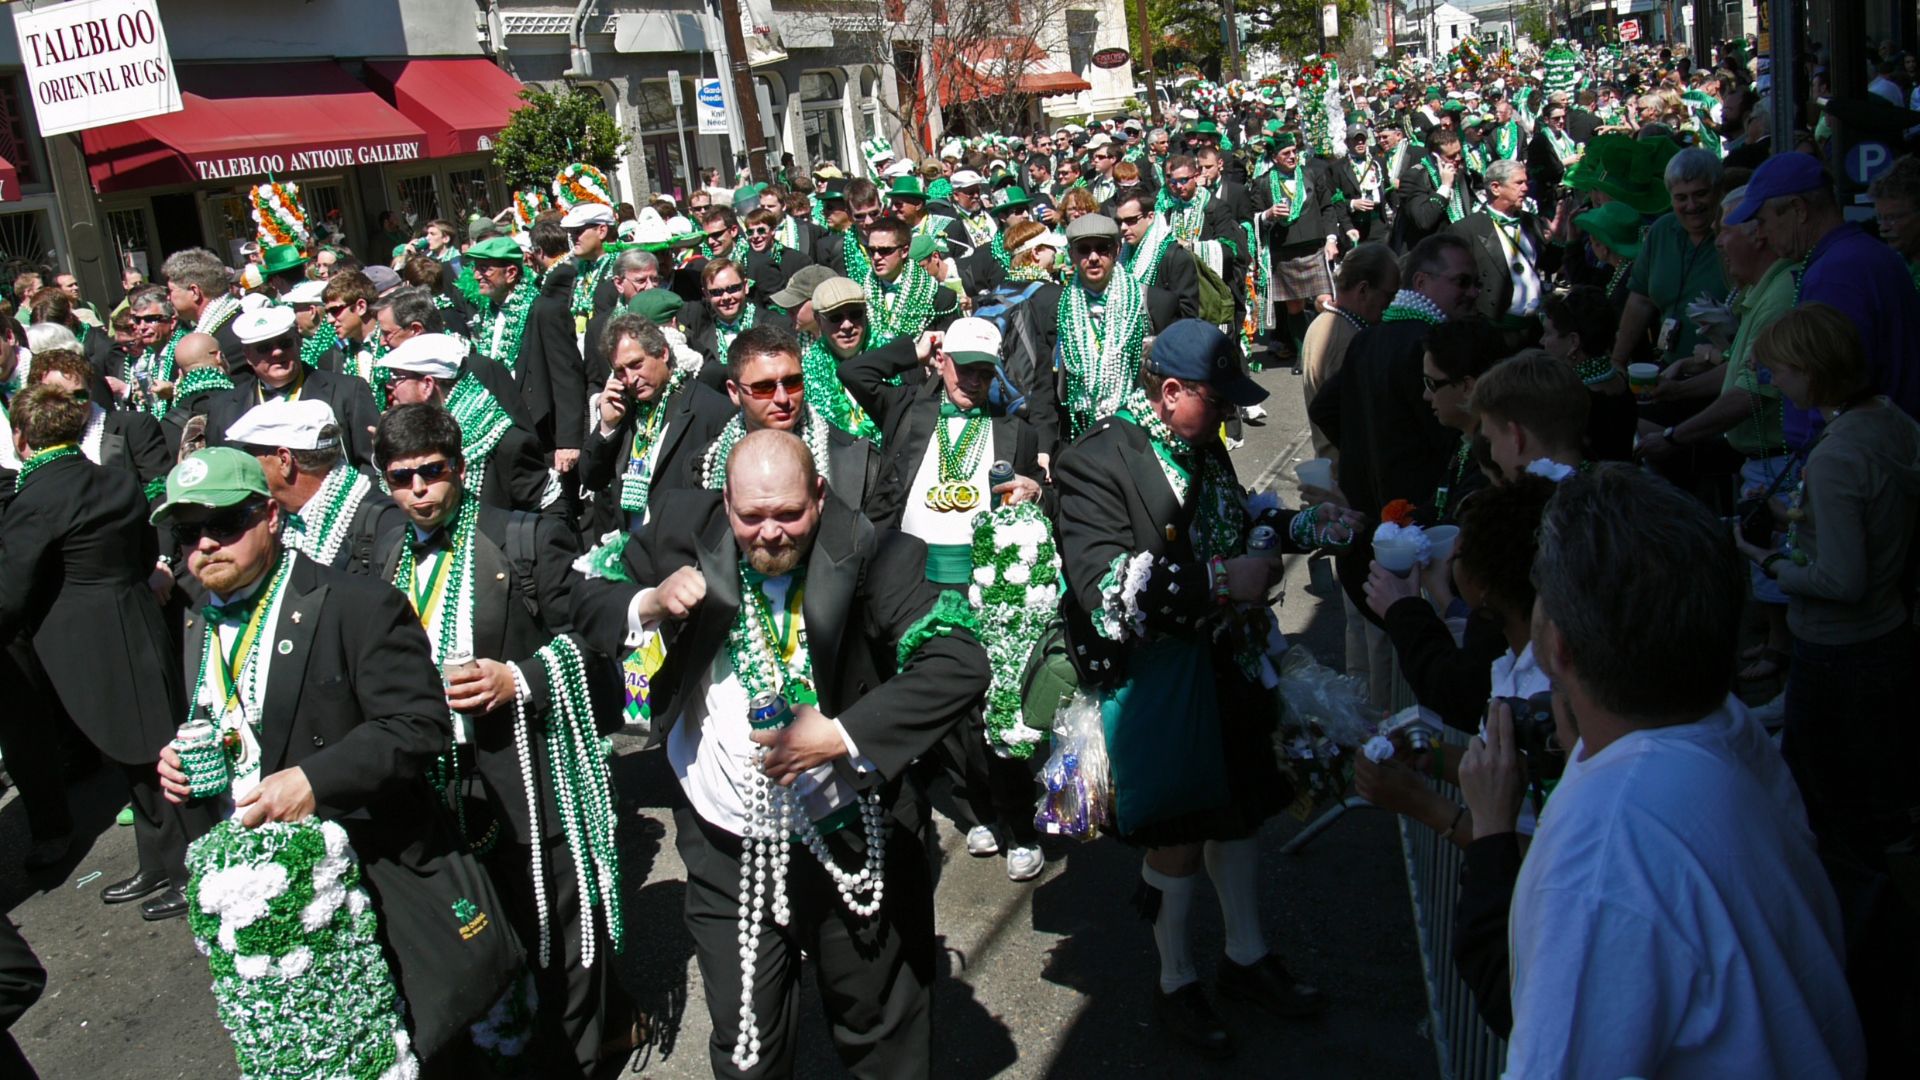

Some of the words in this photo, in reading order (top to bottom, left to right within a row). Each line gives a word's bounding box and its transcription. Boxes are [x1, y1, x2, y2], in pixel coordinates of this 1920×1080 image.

[26, 9, 155, 68] TALEBLOO
[38, 68, 120, 105] ORIENTAL
[120, 57, 167, 89] RUGS
[196, 154, 284, 180] TALEBLOO
[290, 148, 354, 171] ANTIQUE
[358, 142, 420, 164] GALLERY
[1859, 143, 1886, 182] P
